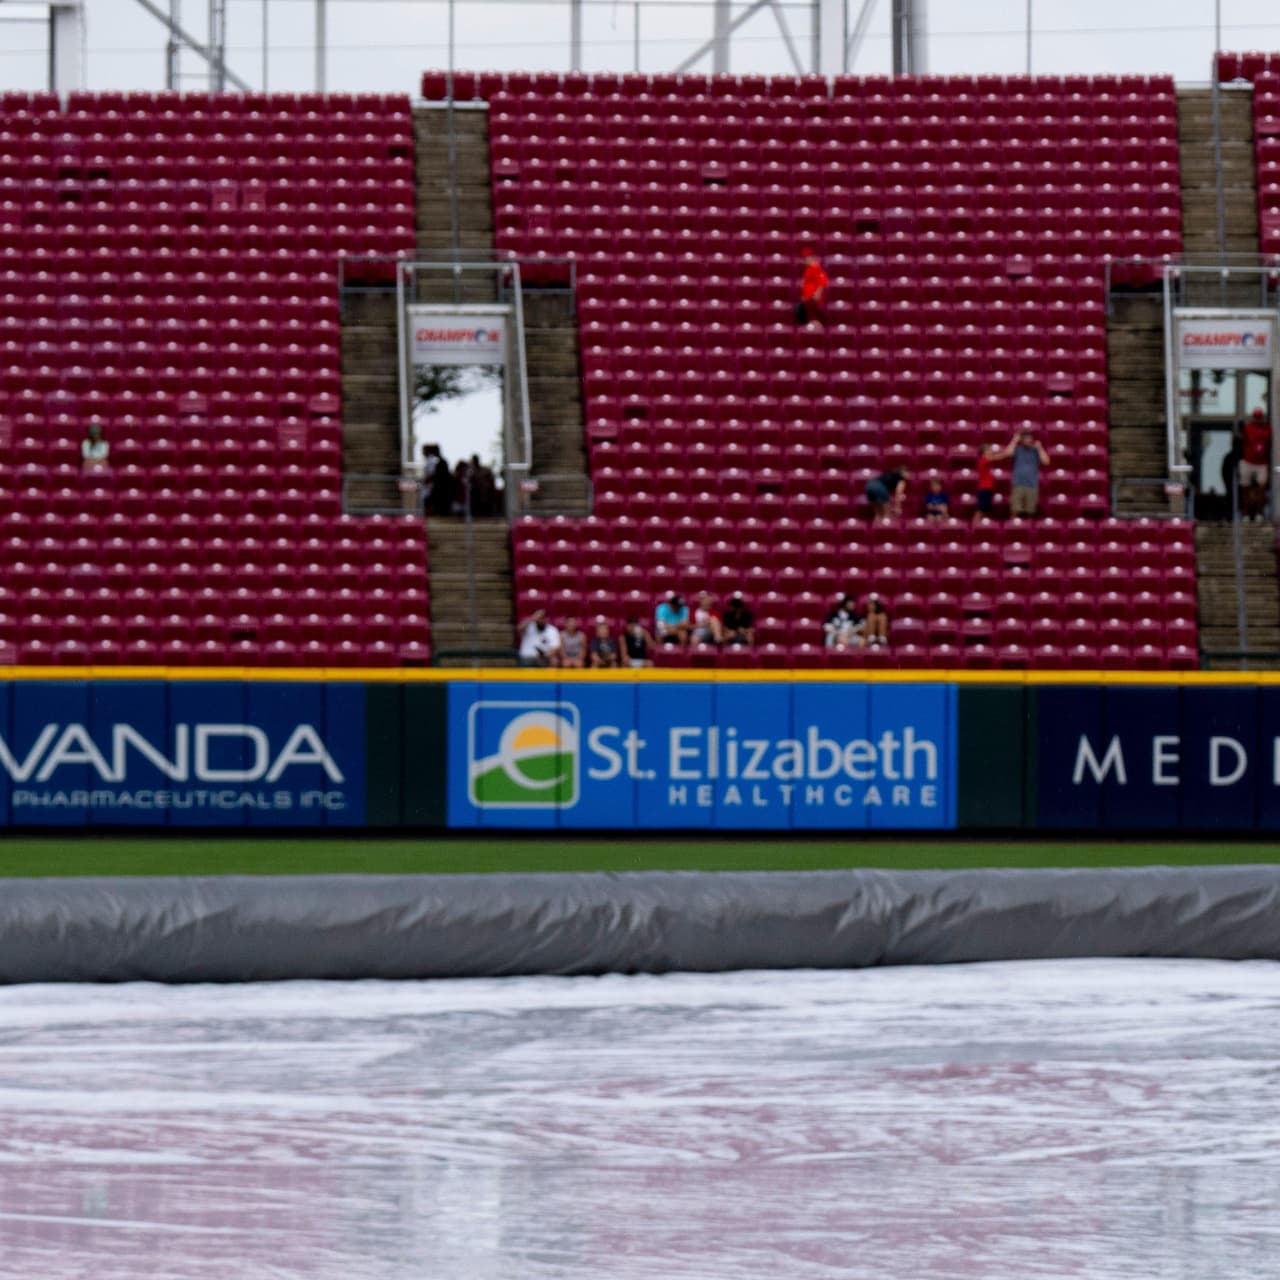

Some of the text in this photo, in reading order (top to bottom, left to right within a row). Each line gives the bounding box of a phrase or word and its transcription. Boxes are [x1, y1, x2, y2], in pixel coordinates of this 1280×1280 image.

[587, 725, 939, 780] St. Elizabeth
[12, 790, 292, 810] PHARMACEUTICALS
[669, 785, 938, 808] HEALTHCARE
